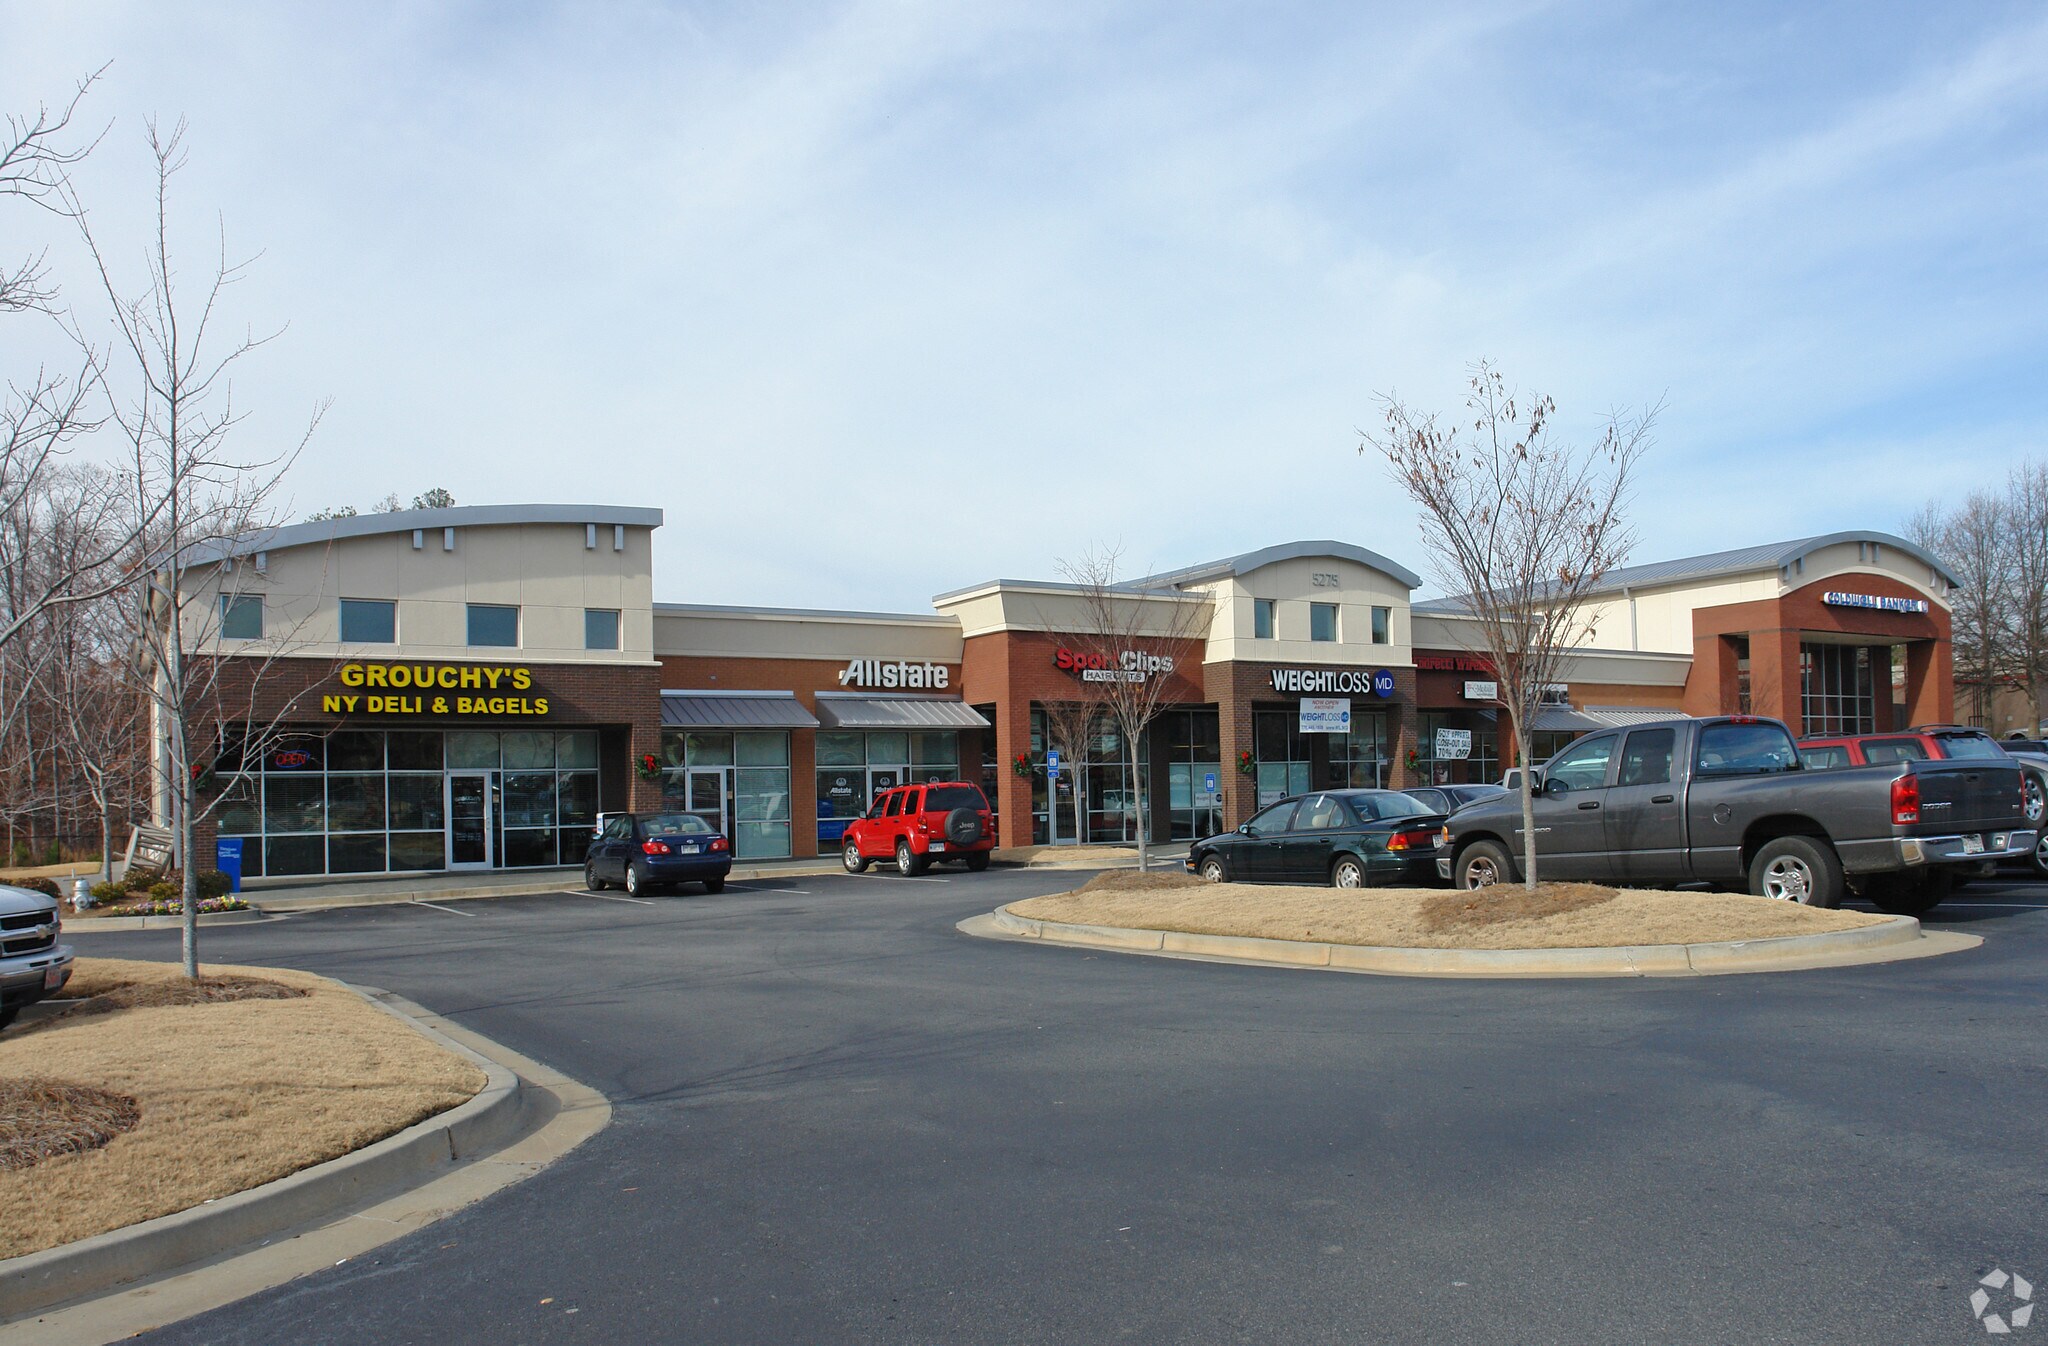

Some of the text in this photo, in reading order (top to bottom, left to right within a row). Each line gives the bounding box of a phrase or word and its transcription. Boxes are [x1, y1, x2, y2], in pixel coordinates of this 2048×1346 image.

[1312, 573, 1338, 587] 5275
[341, 664, 532, 690] GROUCHY'S
[840, 660, 949, 688] Allstate
[1272, 669, 1371, 693] WEIGHTLOSS
[323, 695, 549, 715] NY DELI & BAGELS
[1300, 712, 1341, 721] WEIGHTLOSS
[275, 753, 306, 765] OPEN
[1438, 748, 1469, 757] 70% OFF
